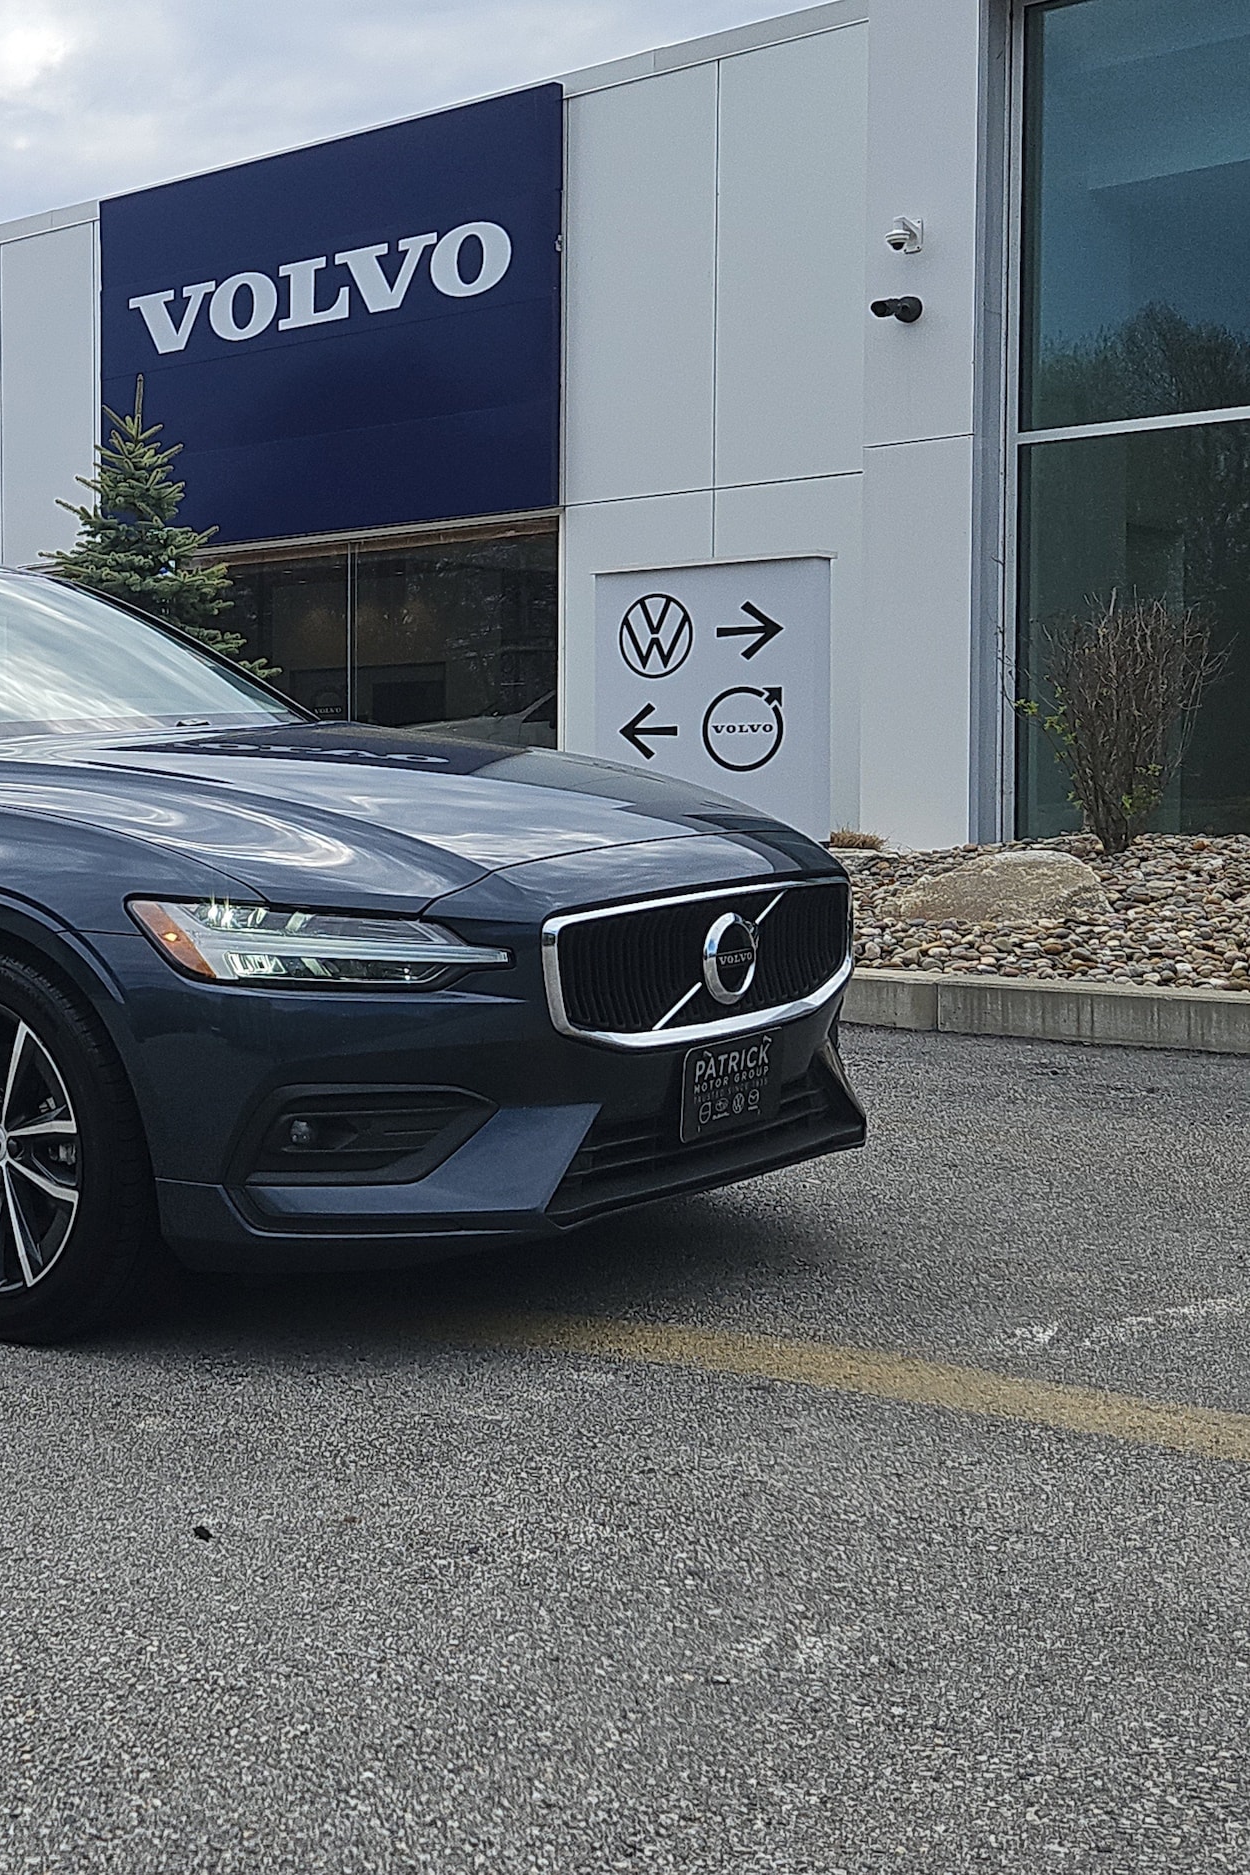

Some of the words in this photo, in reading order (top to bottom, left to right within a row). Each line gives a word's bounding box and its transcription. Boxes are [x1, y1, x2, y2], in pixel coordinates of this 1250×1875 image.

[128, 221, 512, 354] VOLVO
[711, 723, 774, 734] VOLVO
[718, 951, 753, 965] VOLVO
[694, 1043, 771, 1083] PATRICK
[693, 1076, 729, 1094] MOTOR
[734, 1065, 769, 1083] GROUP
